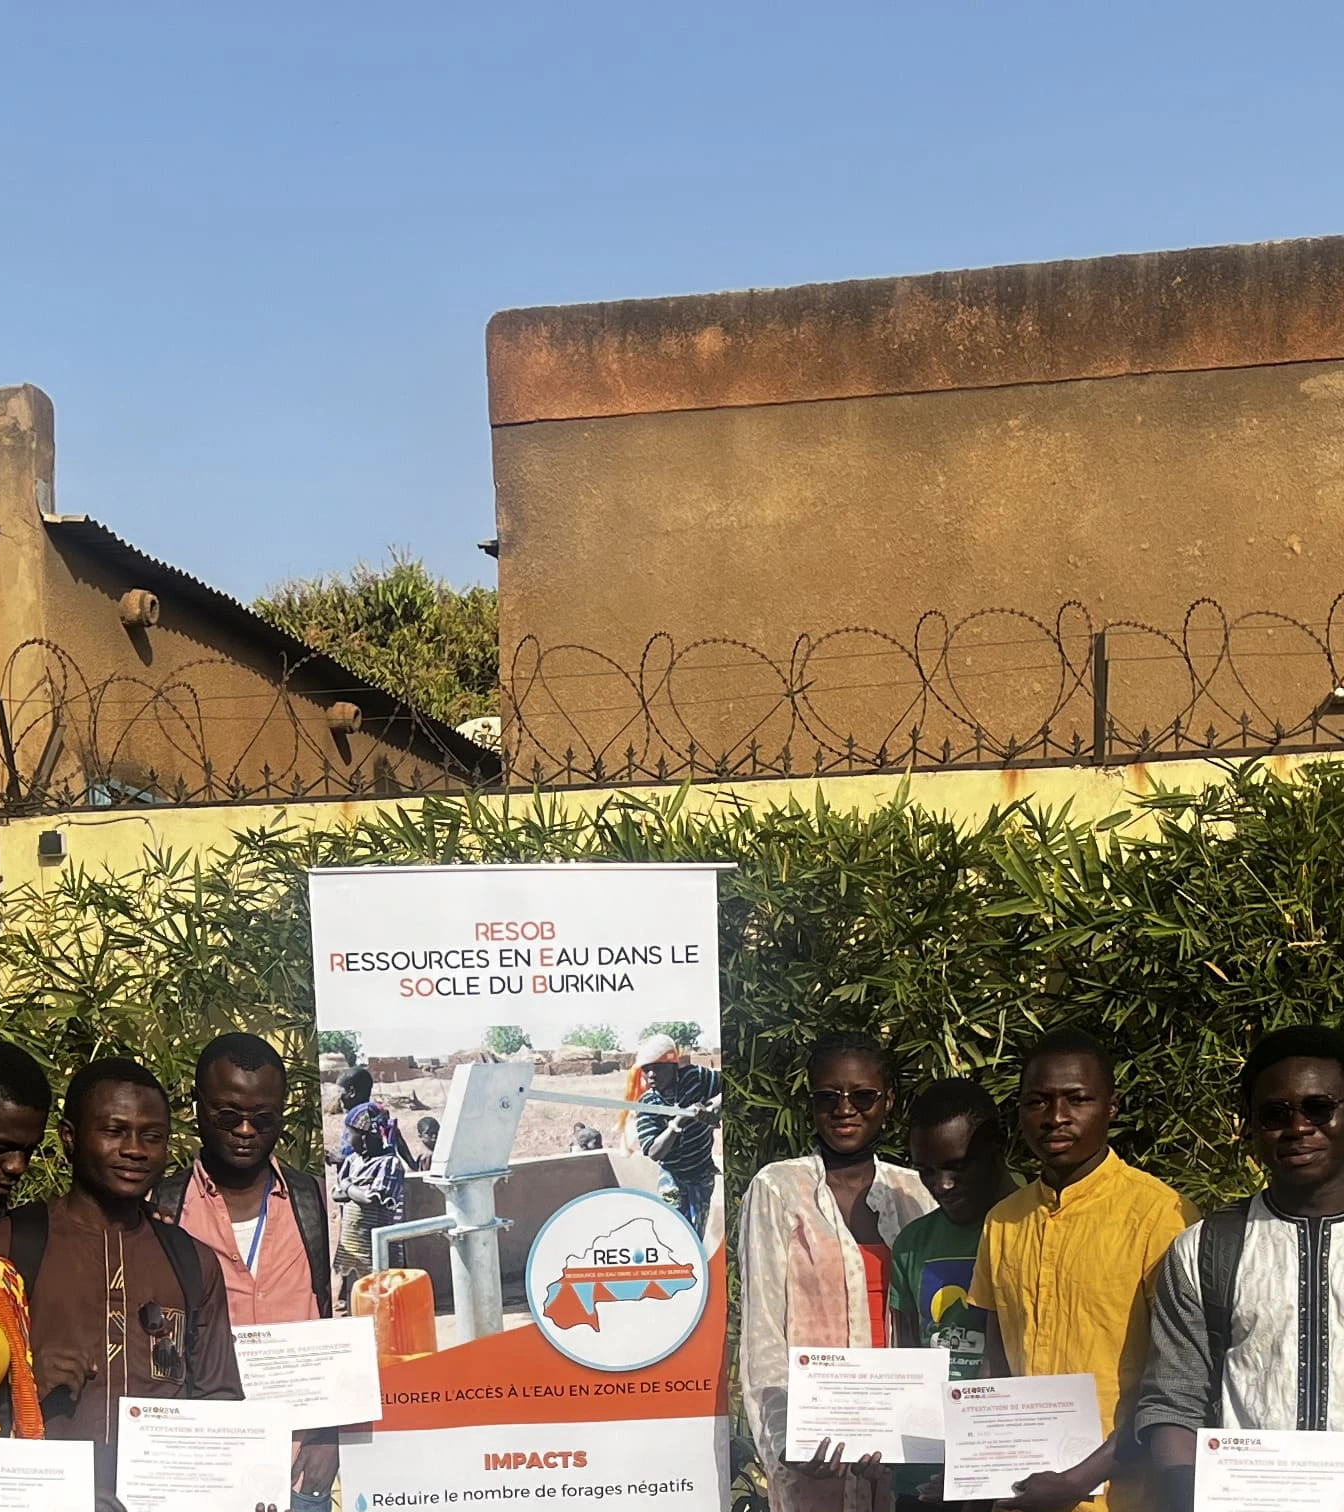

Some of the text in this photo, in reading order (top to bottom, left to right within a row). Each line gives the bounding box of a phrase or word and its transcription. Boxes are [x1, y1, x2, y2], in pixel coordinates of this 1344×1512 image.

[475, 921, 556, 941] RESOB
[329, 945, 700, 972] RESSOURCES EN EAU DANS LE
[399, 973, 635, 997] SOCLE DU BURKINA
[445, 1385, 504, 1402] L'ACCÈS
[507, 1384, 519, 1398] À
[522, 1385, 565, 1398] L'EAU
[570, 1384, 589, 1396] EN
[594, 1382, 636, 1396] ZONE
[640, 1381, 661, 1393] DE
[665, 1379, 712, 1392] SOCLE
[961, 1386, 996, 1395] GEOREVA
[1220, 1437, 1262, 1446] GEOREVA
[484, 1451, 588, 1471] IMPACTS
[372, 1478, 694, 1507] Réduire le nombre de forages négatifs
